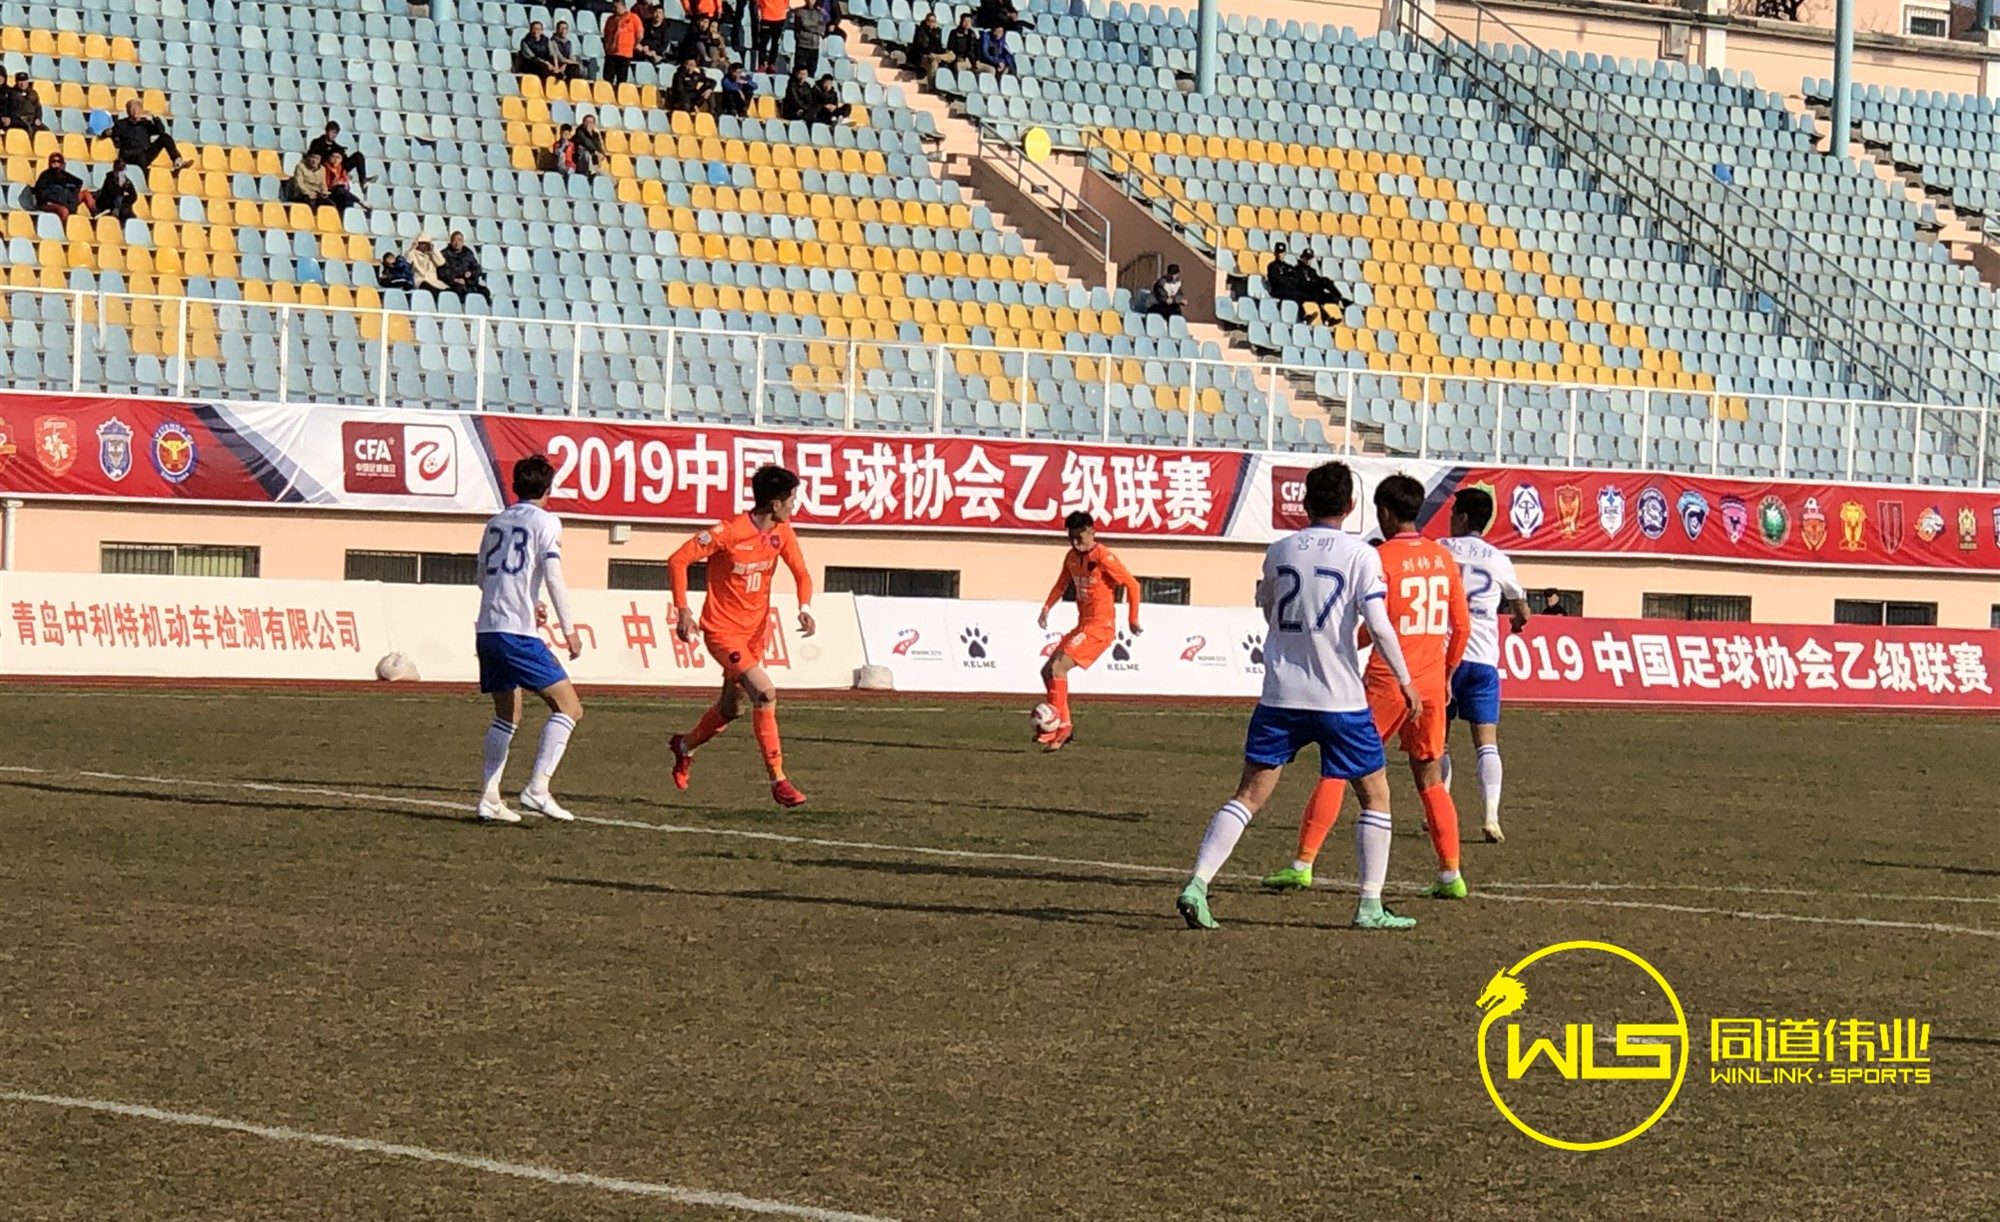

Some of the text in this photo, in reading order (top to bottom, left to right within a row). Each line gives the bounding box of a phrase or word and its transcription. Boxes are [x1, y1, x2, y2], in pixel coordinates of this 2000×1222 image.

[354, 438, 392, 461] CFA
[485, 526, 529, 575] 23
[1275, 564, 1346, 632] 27
[1400, 576, 1449, 636] 36
[1458, 567, 1492, 615] 2
[11, 600, 361, 653] 青岛中利特机动车检测有限公司
[621, 601, 792, 669] 中能团
[963, 660, 997, 669] KELME
[1107, 663, 1140, 672] KELME
[1245, 666, 1265, 674] KEL
[1498, 631, 1993, 694] 019 中国足球协会乙级联赛
